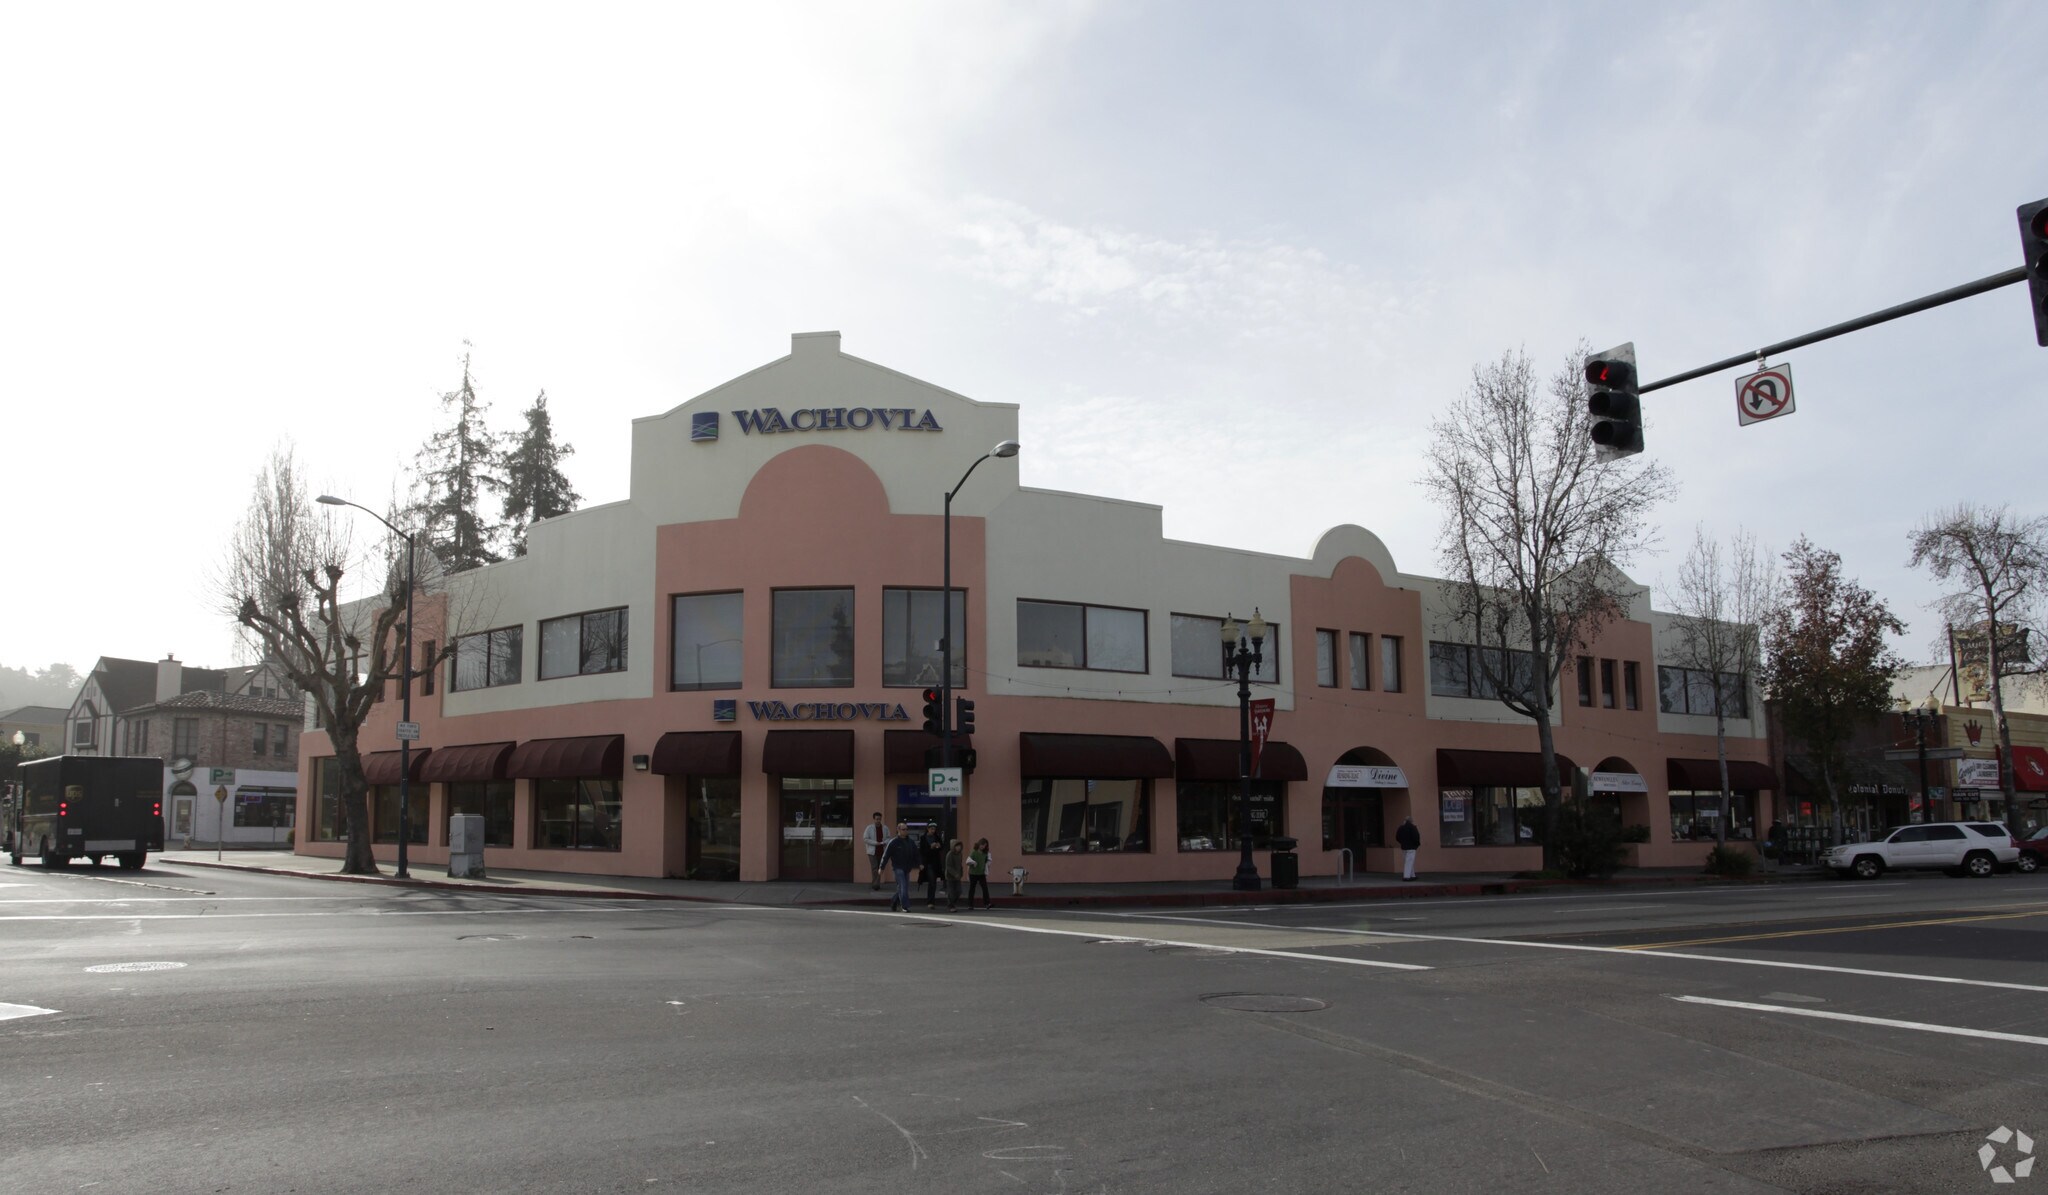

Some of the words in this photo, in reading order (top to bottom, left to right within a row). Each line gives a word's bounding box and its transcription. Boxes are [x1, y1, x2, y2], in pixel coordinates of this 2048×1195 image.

[731, 407, 943, 435] WACHOVIA
[747, 701, 910, 721] WACHOVIA
[1371, 768, 1398, 780] Divine
[1848, 784, 1880, 794] Colonial
